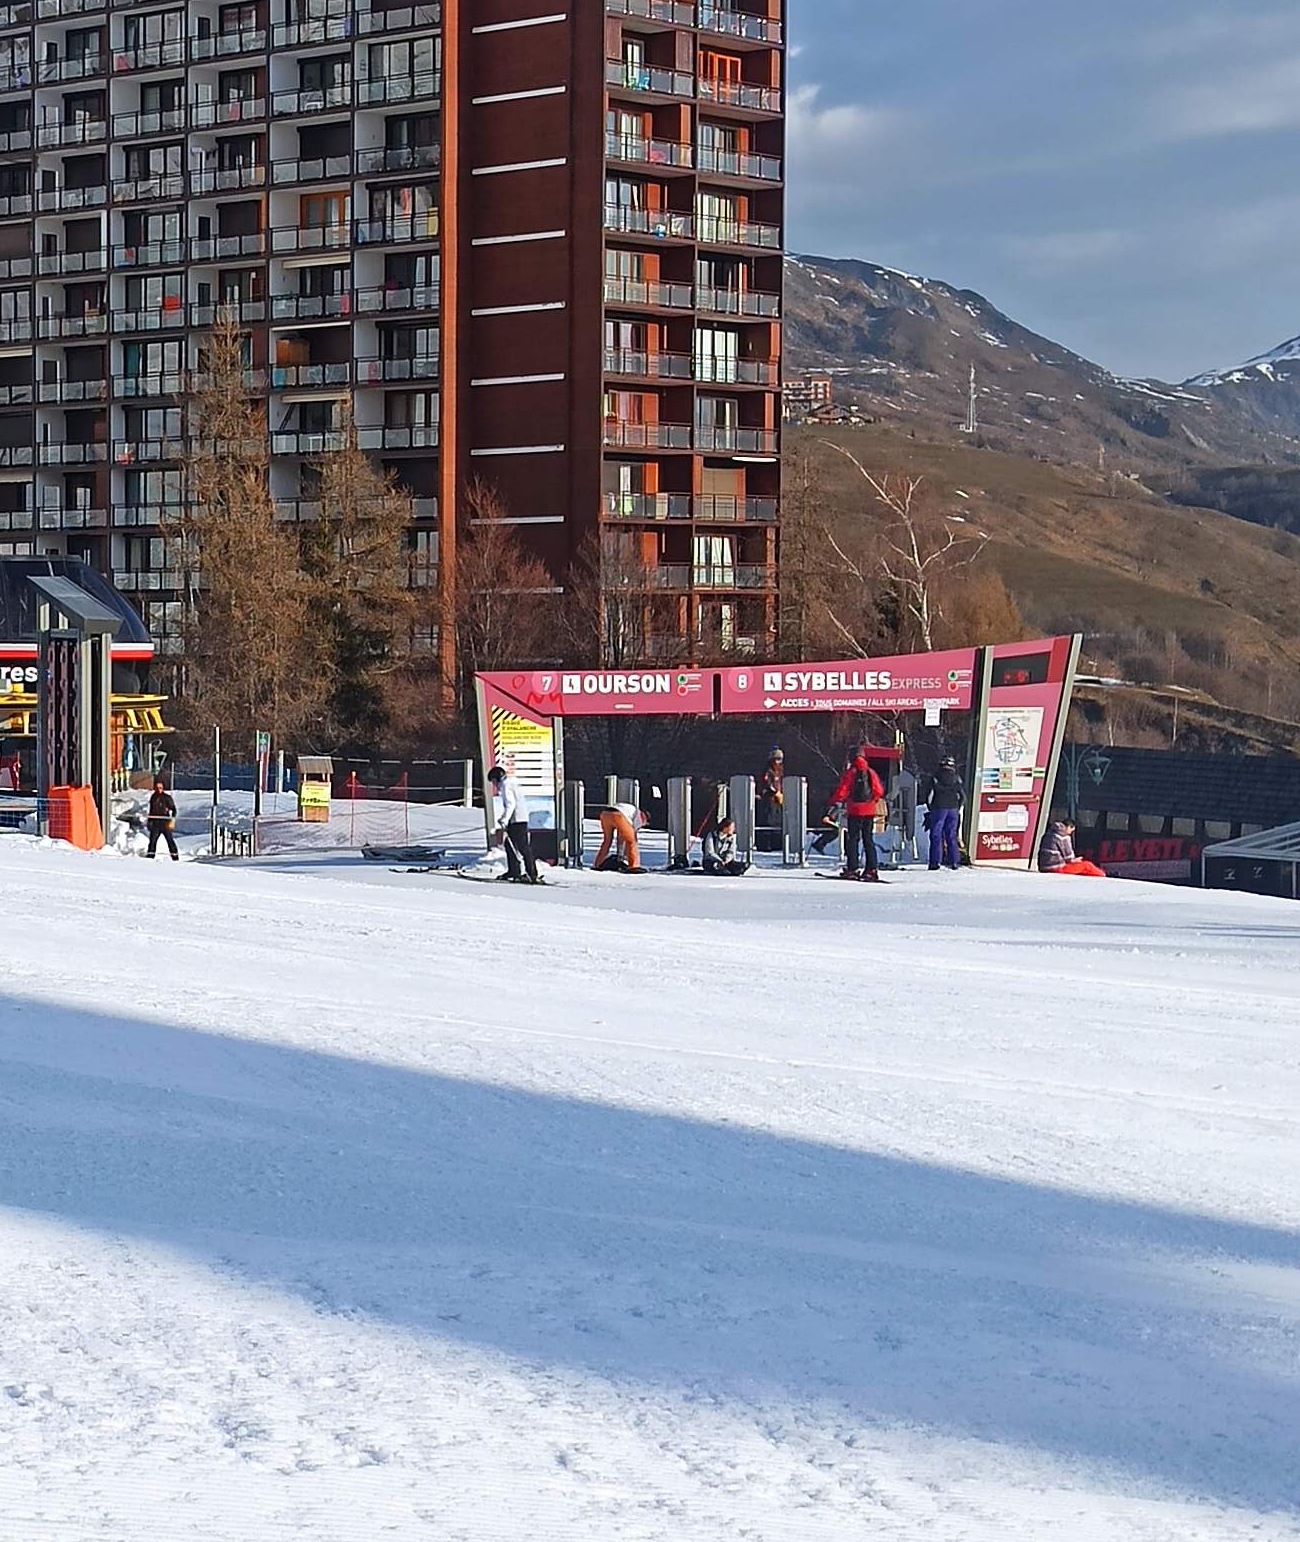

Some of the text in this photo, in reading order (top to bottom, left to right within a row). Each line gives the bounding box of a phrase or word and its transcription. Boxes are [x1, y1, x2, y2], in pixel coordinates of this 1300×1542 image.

[541, 675, 552, 692] 7
[583, 673, 671, 694] OURSON
[738, 674, 748, 689] 8
[784, 670, 892, 691] SYBELLES
[892, 677, 943, 690] EXPRESS
[833, 698, 867, 707] DOMAINES
[871, 698, 885, 707] ALL
[885, 698, 896, 706] SKI
[896, 698, 918, 706] AREAS
[1099, 838, 1182, 862] LE YETI
